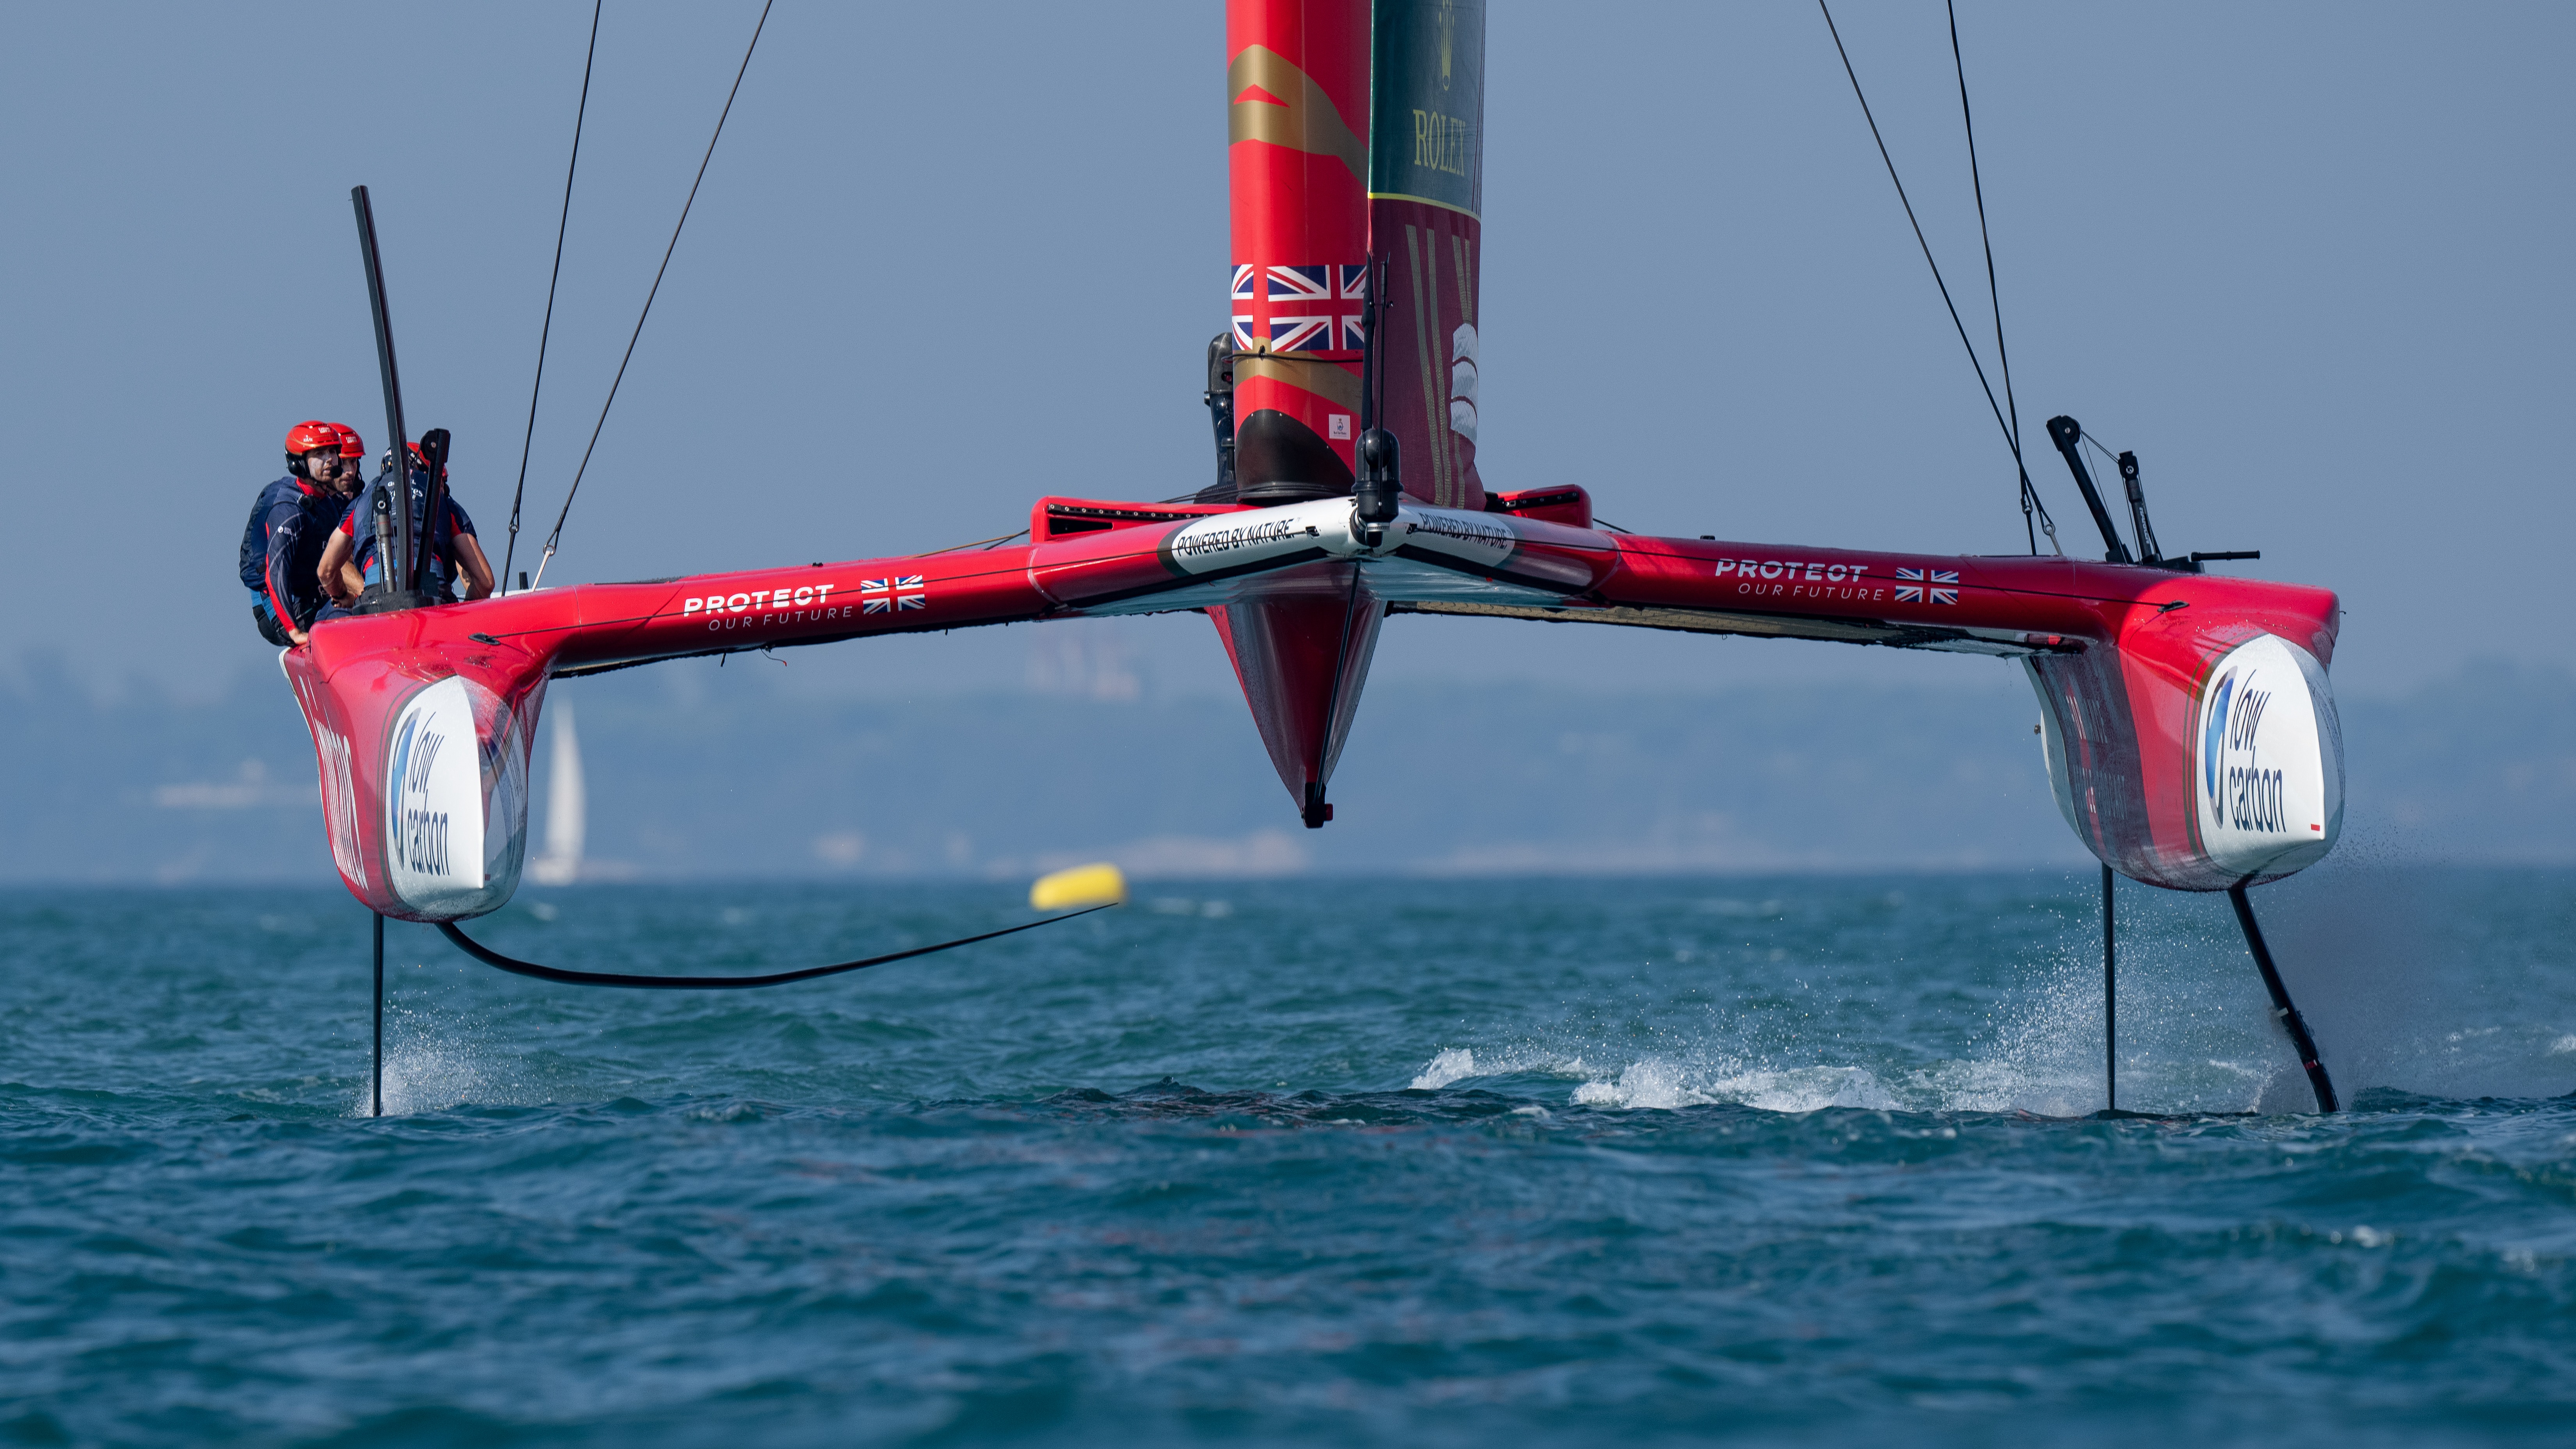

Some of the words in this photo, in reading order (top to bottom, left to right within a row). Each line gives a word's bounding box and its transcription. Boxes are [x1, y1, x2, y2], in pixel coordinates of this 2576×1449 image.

[1413, 109, 1466, 176] ROLEX
[1177, 530, 1229, 557] POWERED
[1231, 526, 1249, 549] BY
[1418, 512, 1463, 539] POWERED
[1461, 520, 1474, 542] BY
[1715, 558, 1869, 582] PROTECT
[684, 583, 834, 617] PROTECT
[1739, 583, 1783, 596] OUR
[1793, 585, 1884, 601] FUTURE
[709, 616, 752, 631] OUR
[763, 606, 853, 626] FUTURE
[2230, 669, 2271, 751] low
[408, 711, 445, 794] low
[2230, 745, 2286, 833] carbon
[407, 788, 450, 876] carbon
